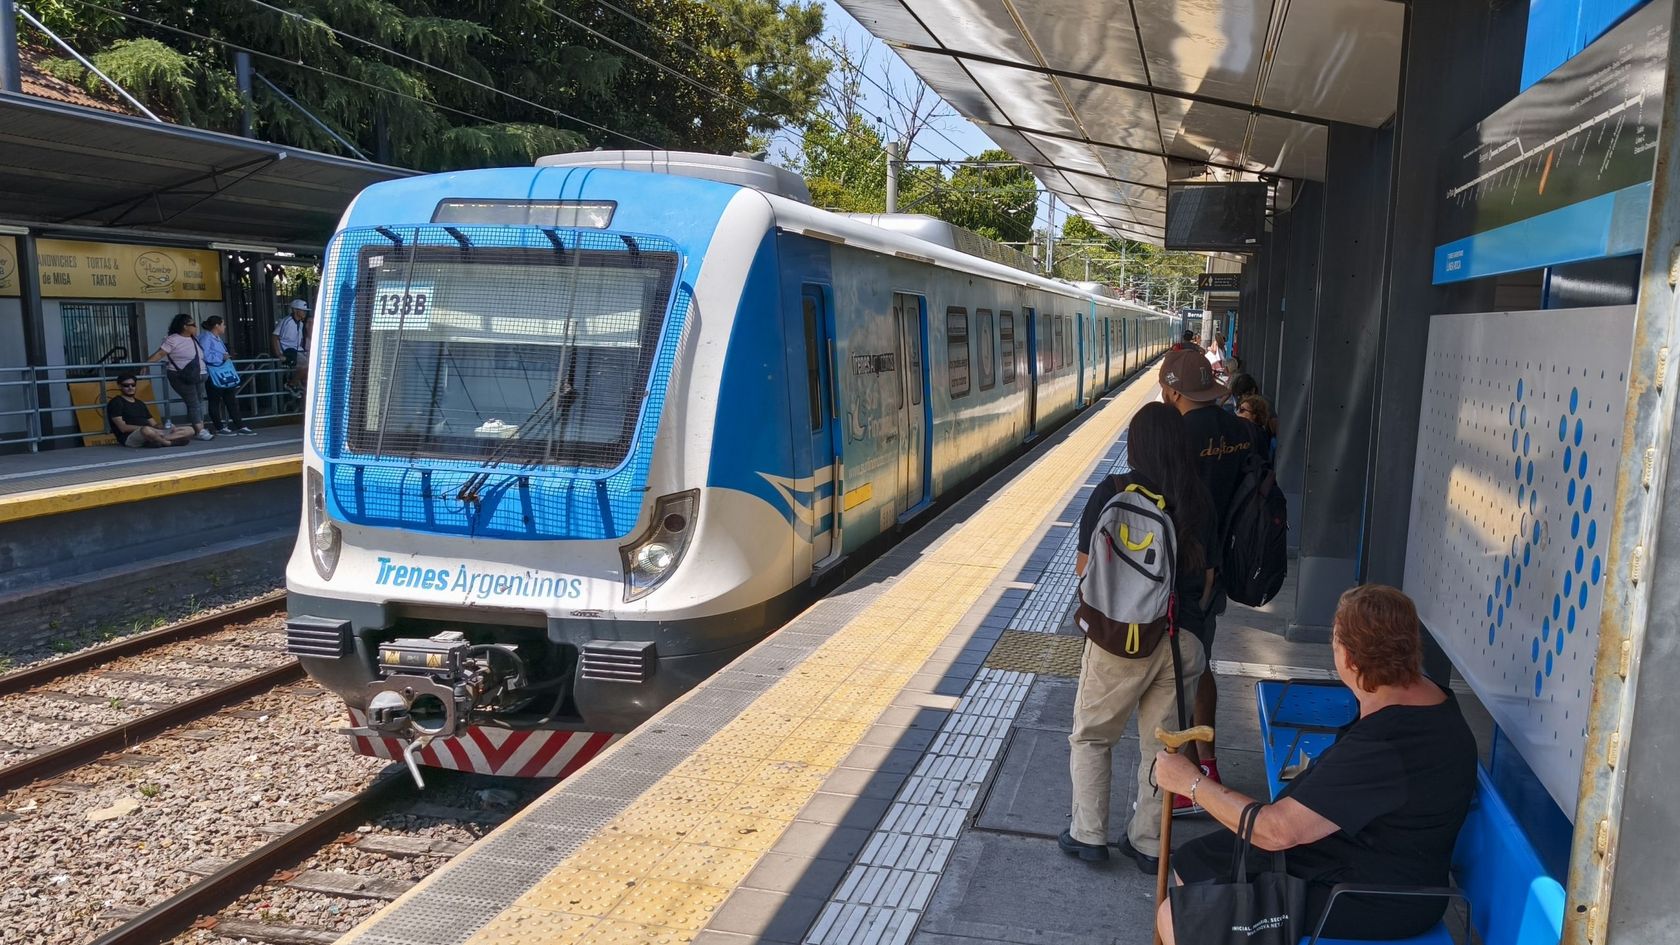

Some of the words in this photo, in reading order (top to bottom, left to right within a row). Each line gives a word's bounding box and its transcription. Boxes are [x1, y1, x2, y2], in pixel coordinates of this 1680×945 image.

[37, 254, 77, 268] ANDWICHES
[87, 256, 111, 270] TORTAS
[112, 258, 119, 270] &
[42, 272, 51, 284] de
[53, 272, 71, 285] MIGA
[91, 273, 117, 287] TARTAS
[1199, 435, 1251, 461] deftone
[376, 556, 450, 591] Trenes
[451, 564, 582, 599] Argentinos
